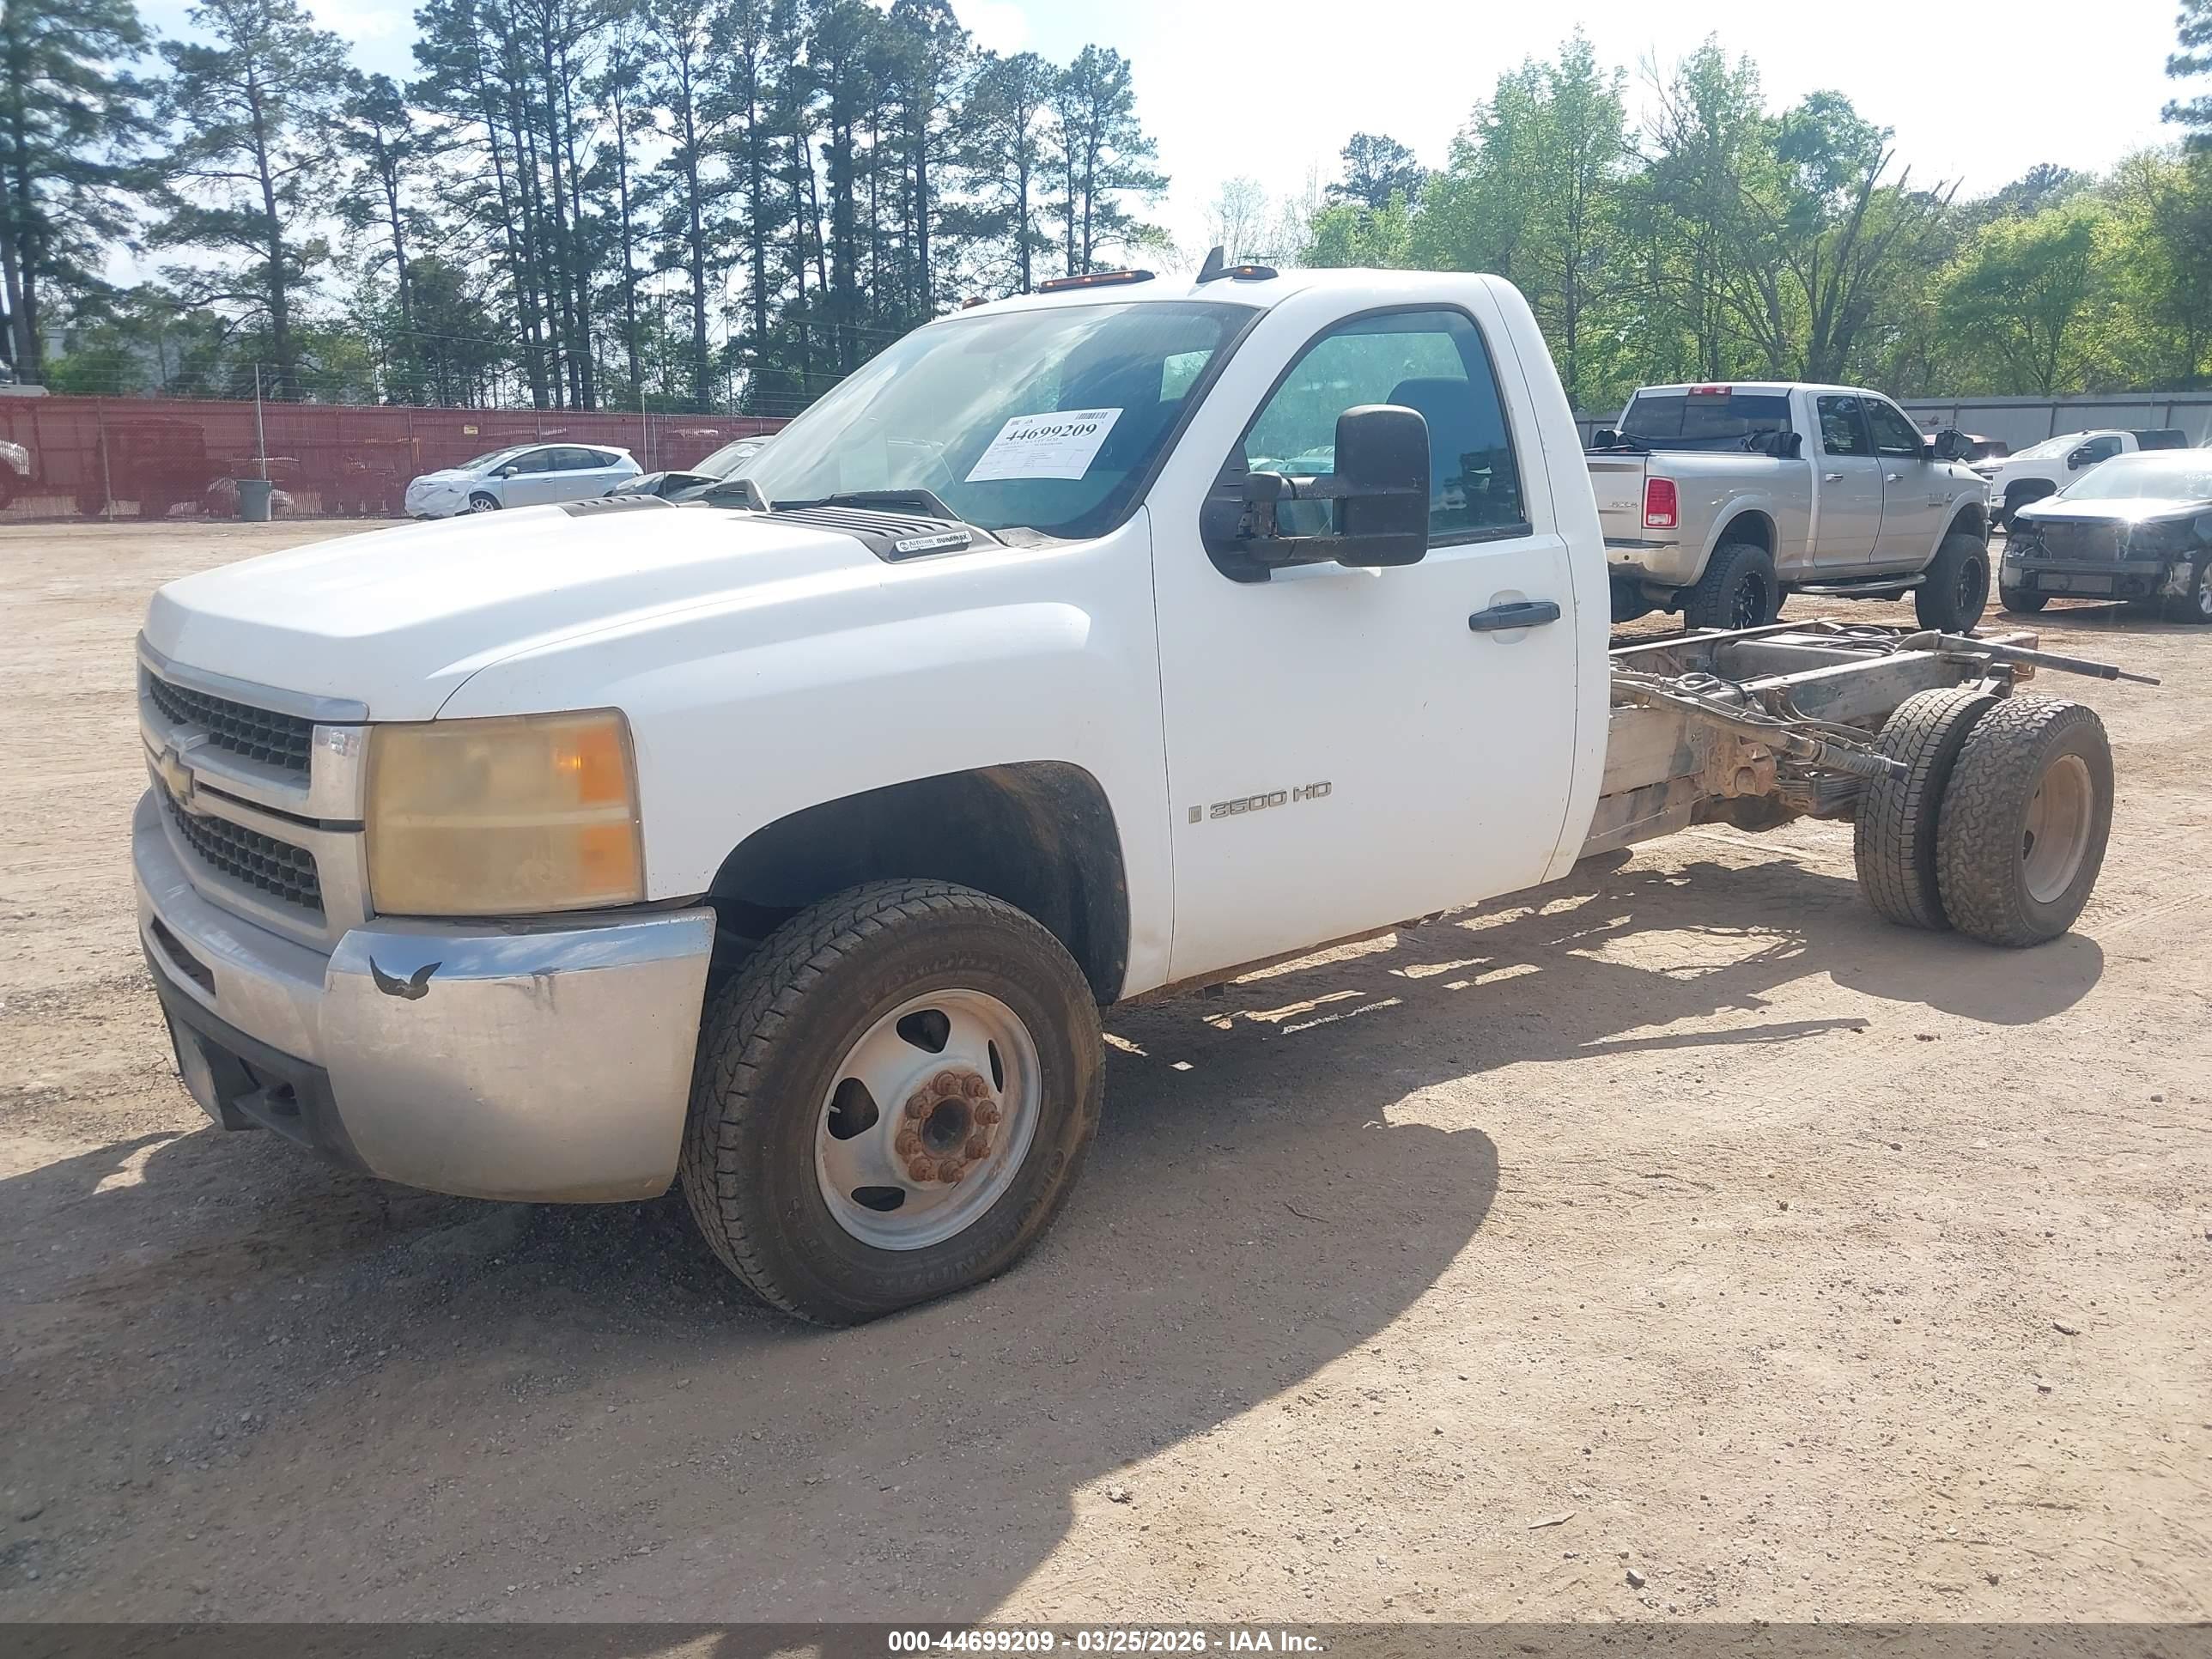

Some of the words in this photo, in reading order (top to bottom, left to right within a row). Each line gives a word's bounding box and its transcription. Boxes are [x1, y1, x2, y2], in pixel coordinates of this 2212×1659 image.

[1006, 423, 1097, 441] 44699209
[1210, 790, 1288, 819] 3500
[1292, 781, 1332, 802] HD
